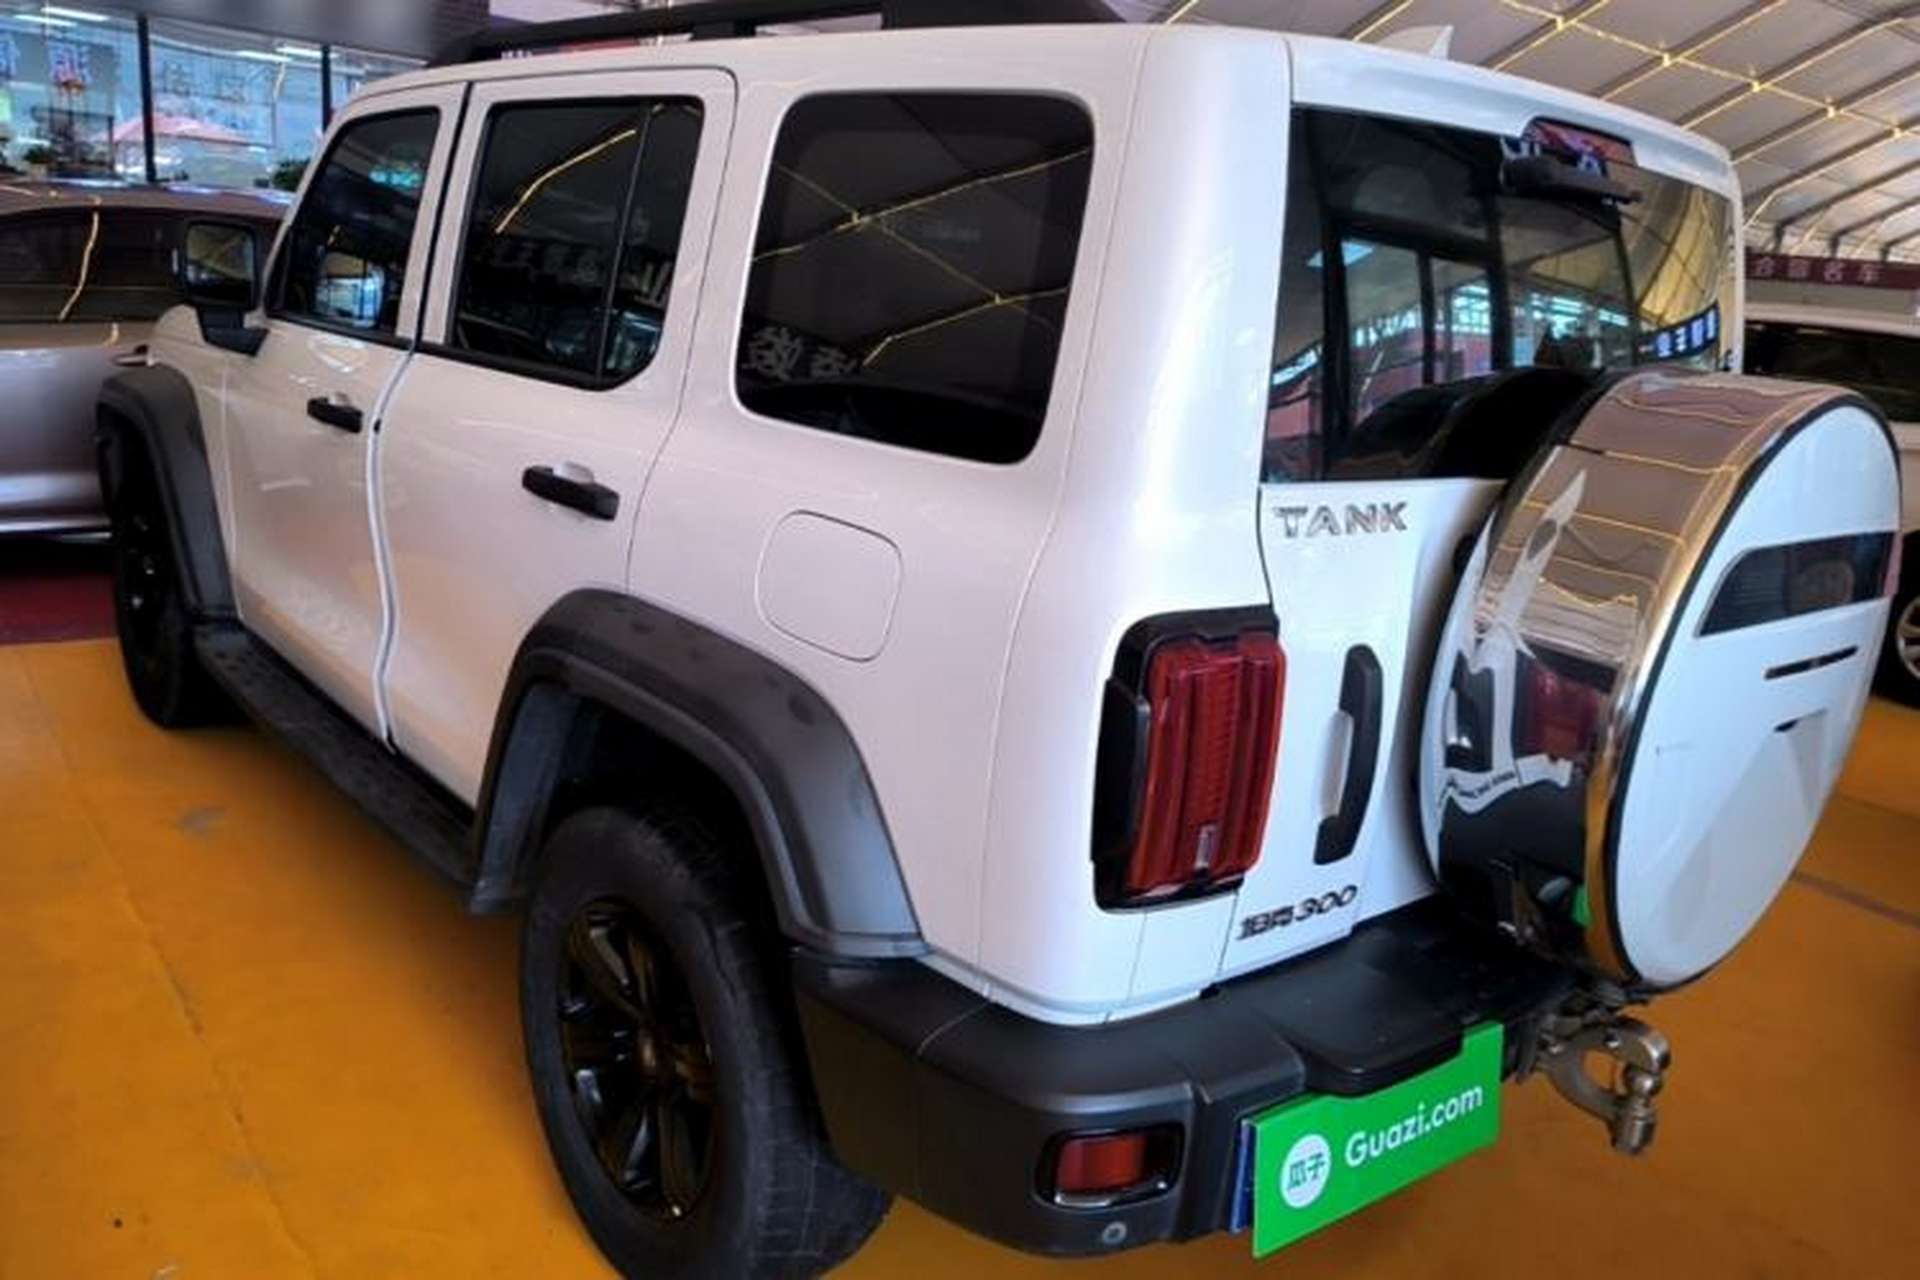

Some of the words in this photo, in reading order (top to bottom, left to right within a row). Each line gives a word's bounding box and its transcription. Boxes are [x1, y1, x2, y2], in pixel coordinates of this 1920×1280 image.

[1273, 501, 1408, 538] TANK
[1344, 1085, 1484, 1168] Guazi.com
[1287, 1151, 1327, 1190] 瓜子
